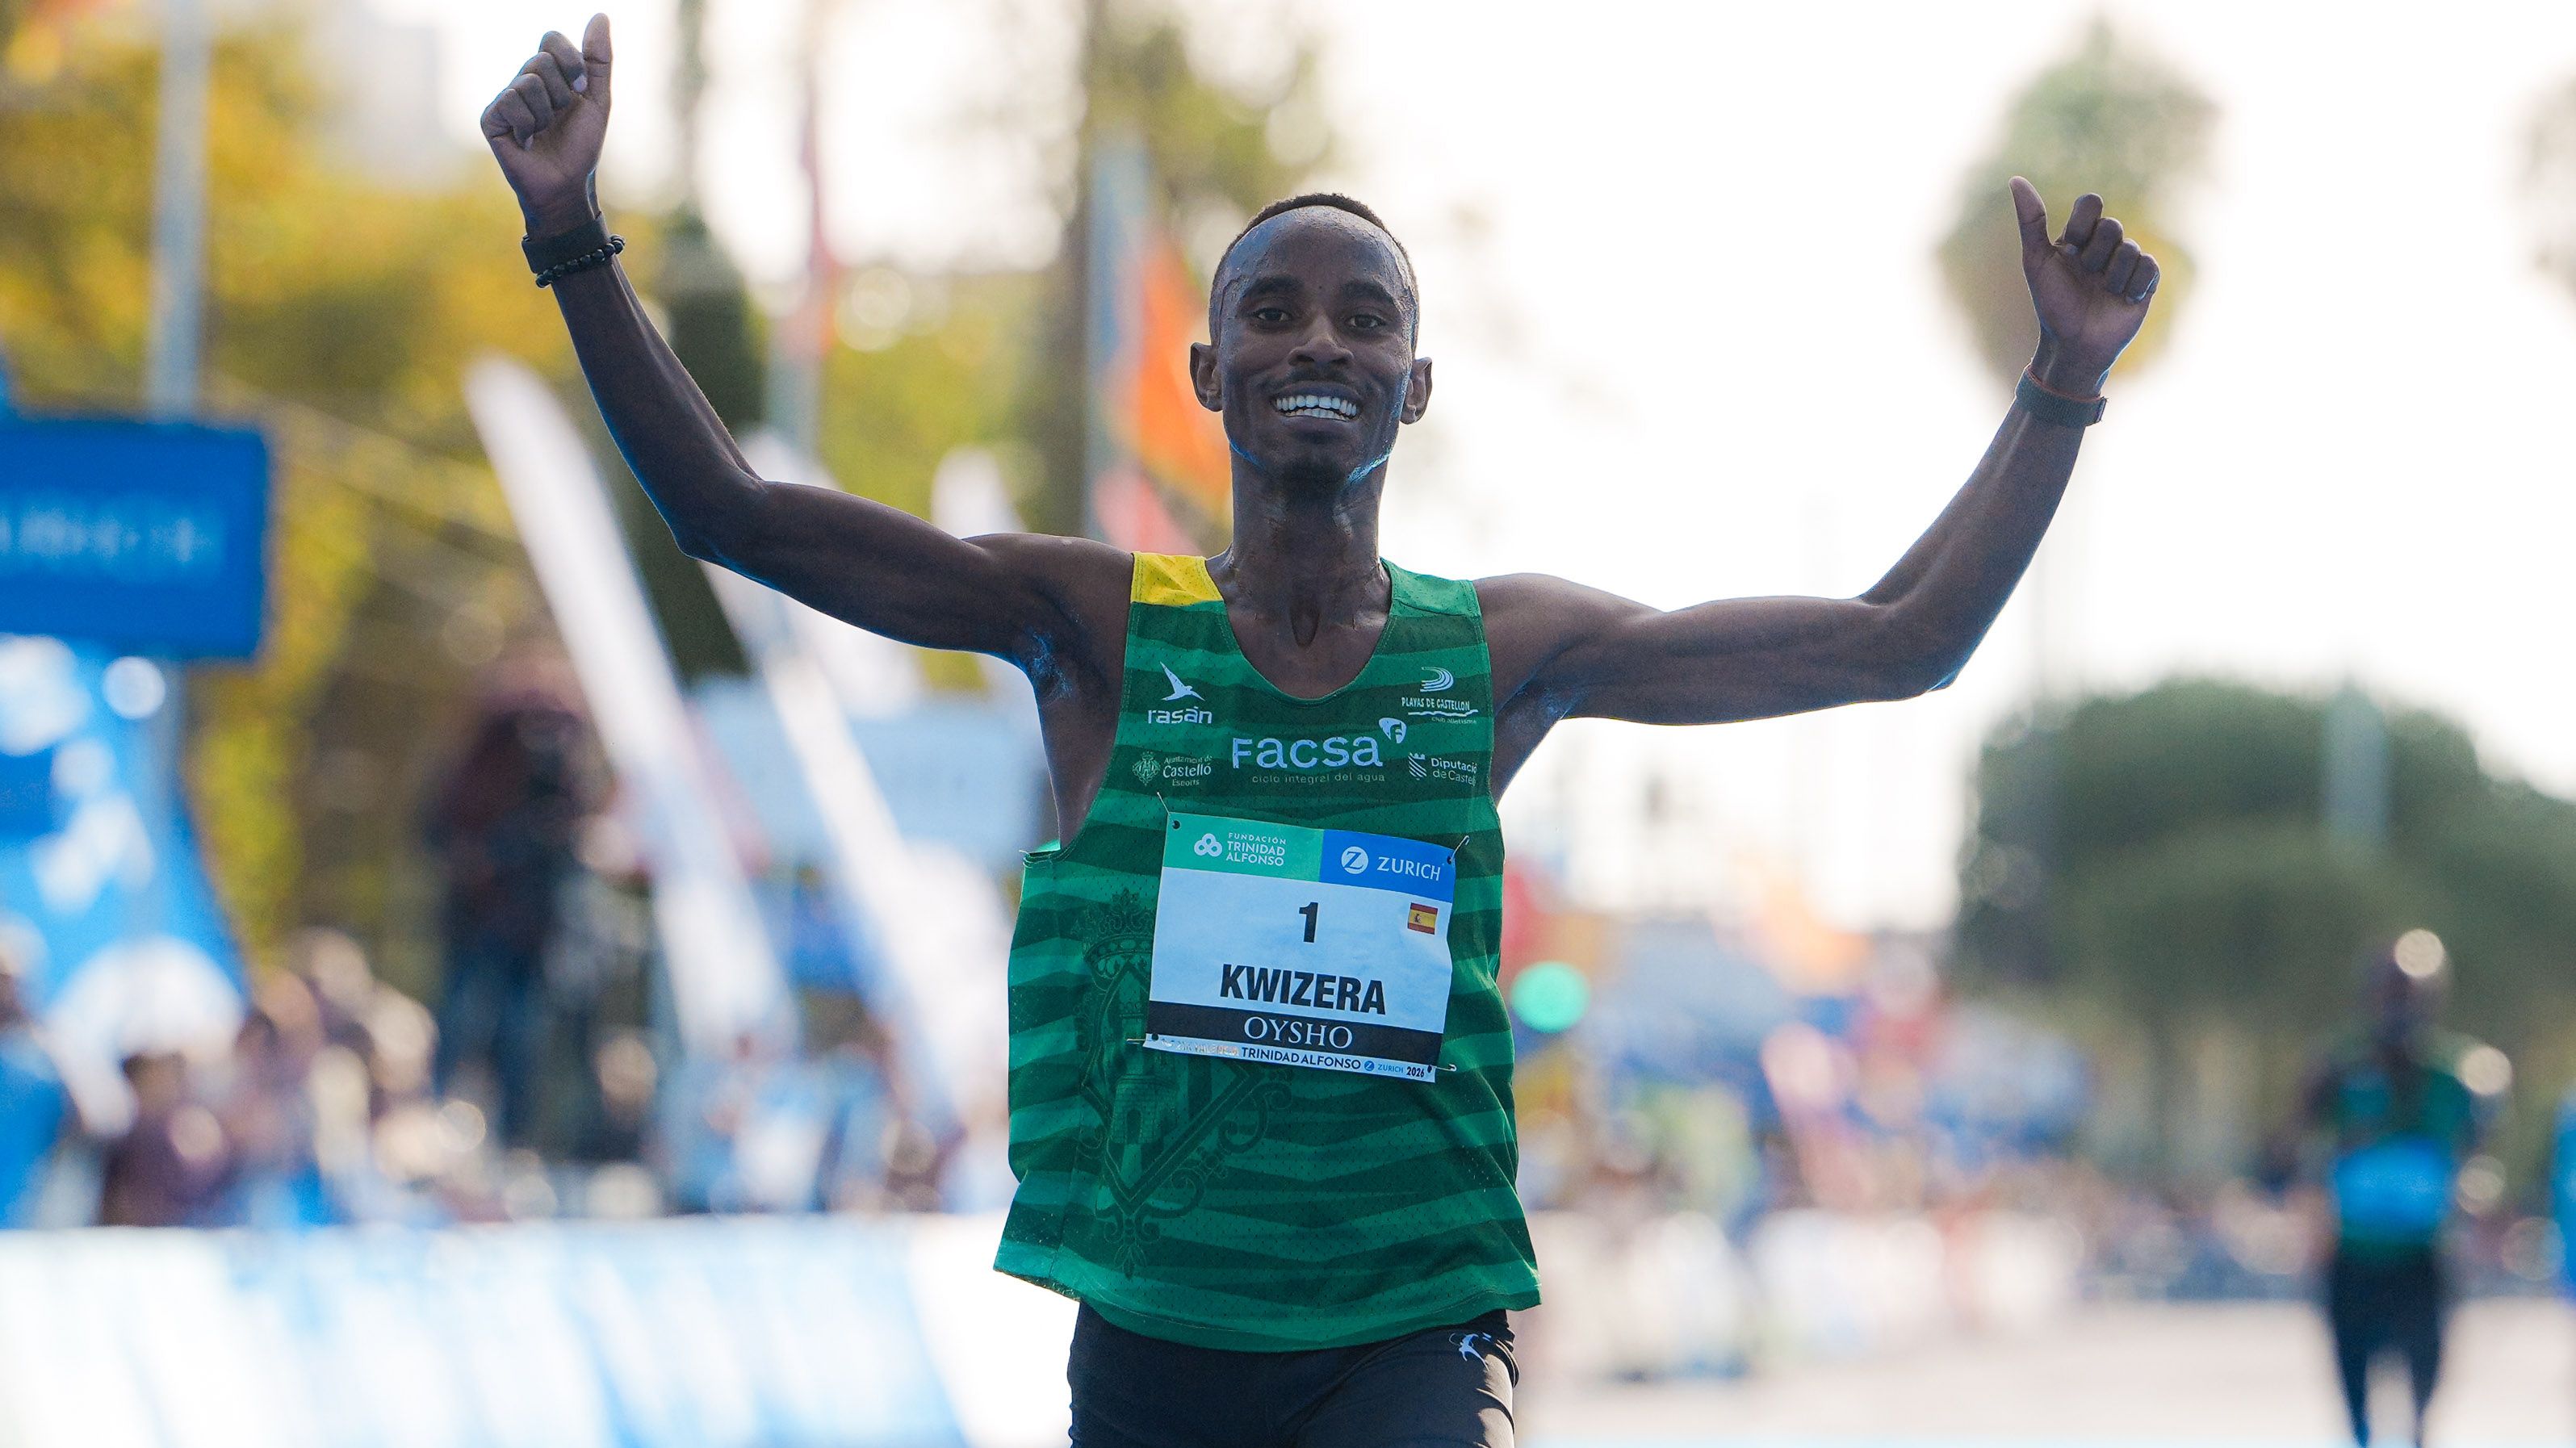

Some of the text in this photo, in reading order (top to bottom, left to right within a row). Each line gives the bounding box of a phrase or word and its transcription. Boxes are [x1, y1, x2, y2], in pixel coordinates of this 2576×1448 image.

[1401, 697, 1425, 707] PLAYAS
[1426, 697, 1435, 708] DE
[1232, 735, 1384, 768] Facsa
[1162, 762, 1212, 778] Castelló
[1432, 769, 1447, 779] de
[1252, 772, 1385, 785] ciclo integral del agua
[1228, 832, 1287, 845] FUNDACIÓN
[1226, 840, 1285, 856] TRINIDAD
[1225, 852, 1284, 866] ALFONSO
[1376, 856, 1441, 881] ZURICH
[1299, 902, 1318, 943] 1
[1220, 963, 1386, 1015] KWIZERA
[1244, 1016, 1353, 1048] OYSHO
[1242, 1047, 1299, 1064] TRINIDAD
[1301, 1053, 1362, 1070] ALFONSO
[1377, 1063, 1404, 1073] ZURICH
[1406, 1065, 1425, 1078] 2026
